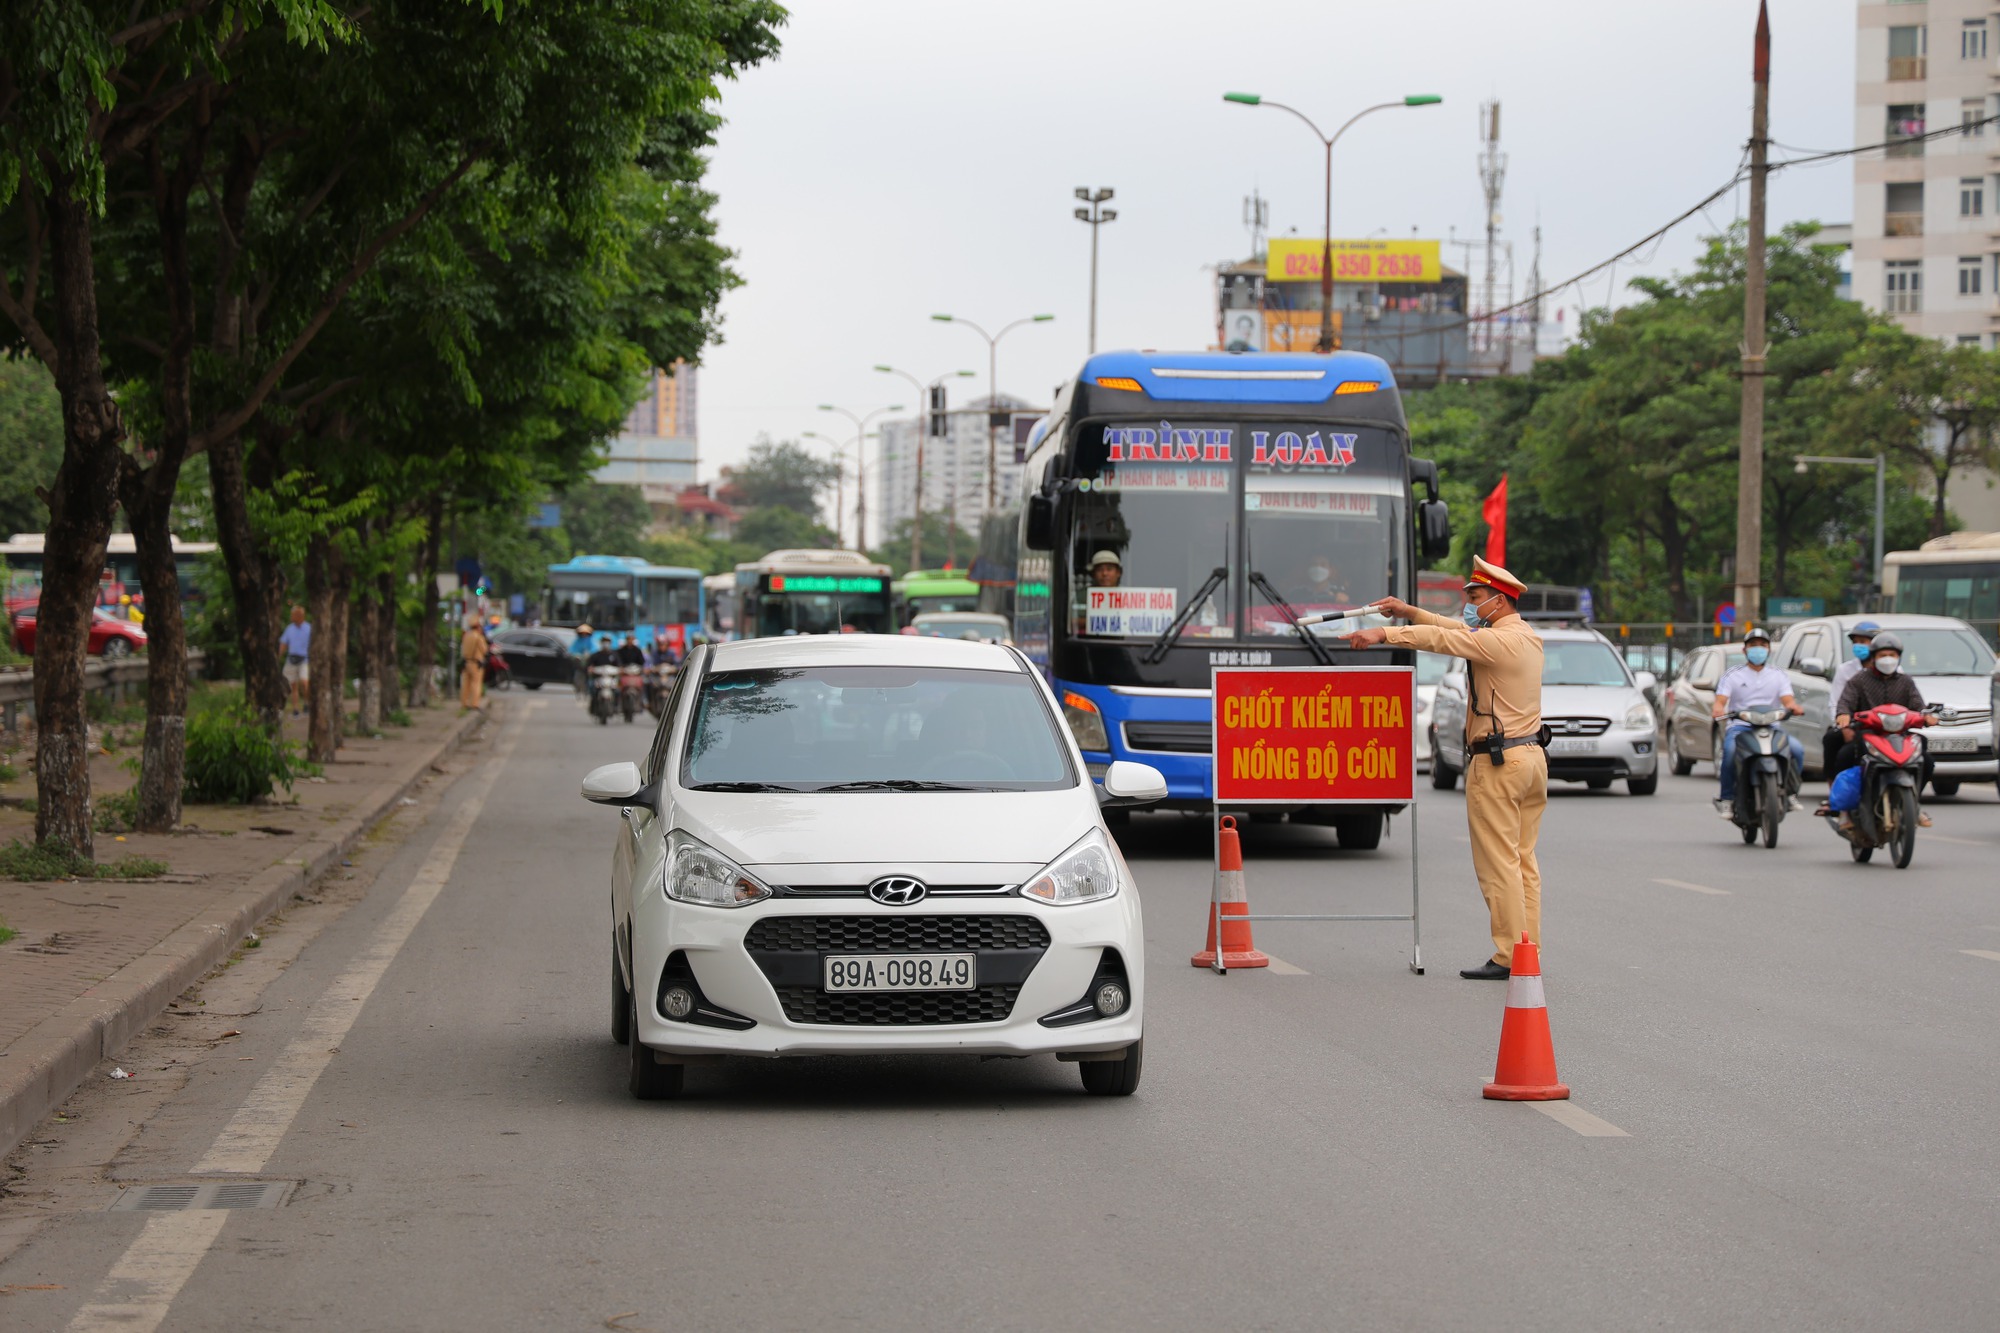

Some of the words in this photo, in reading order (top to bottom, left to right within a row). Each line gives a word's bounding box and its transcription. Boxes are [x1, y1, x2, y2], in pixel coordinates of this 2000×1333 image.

[1337, 253, 1372, 276] 350
[1378, 254, 1423, 276] 2636
[1102, 420, 1233, 463] TRÌNH
[1250, 430, 1358, 466] LOAN
[1119, 470, 1153, 487] THANH
[1091, 592, 1104, 609] TP
[1108, 592, 1146, 609] THANH
[1149, 588, 1173, 609] HÓA
[1224, 687, 1285, 728] CHỐT
[1292, 684, 1353, 728] KIỂM
[1360, 695, 1405, 728] TRA
[1233, 738, 1299, 779] NỒNG
[1306, 740, 1339, 785] ĐỘ
[1347, 737, 1396, 779] CỒN
[830, 959, 969, 987] 89A-098.49
